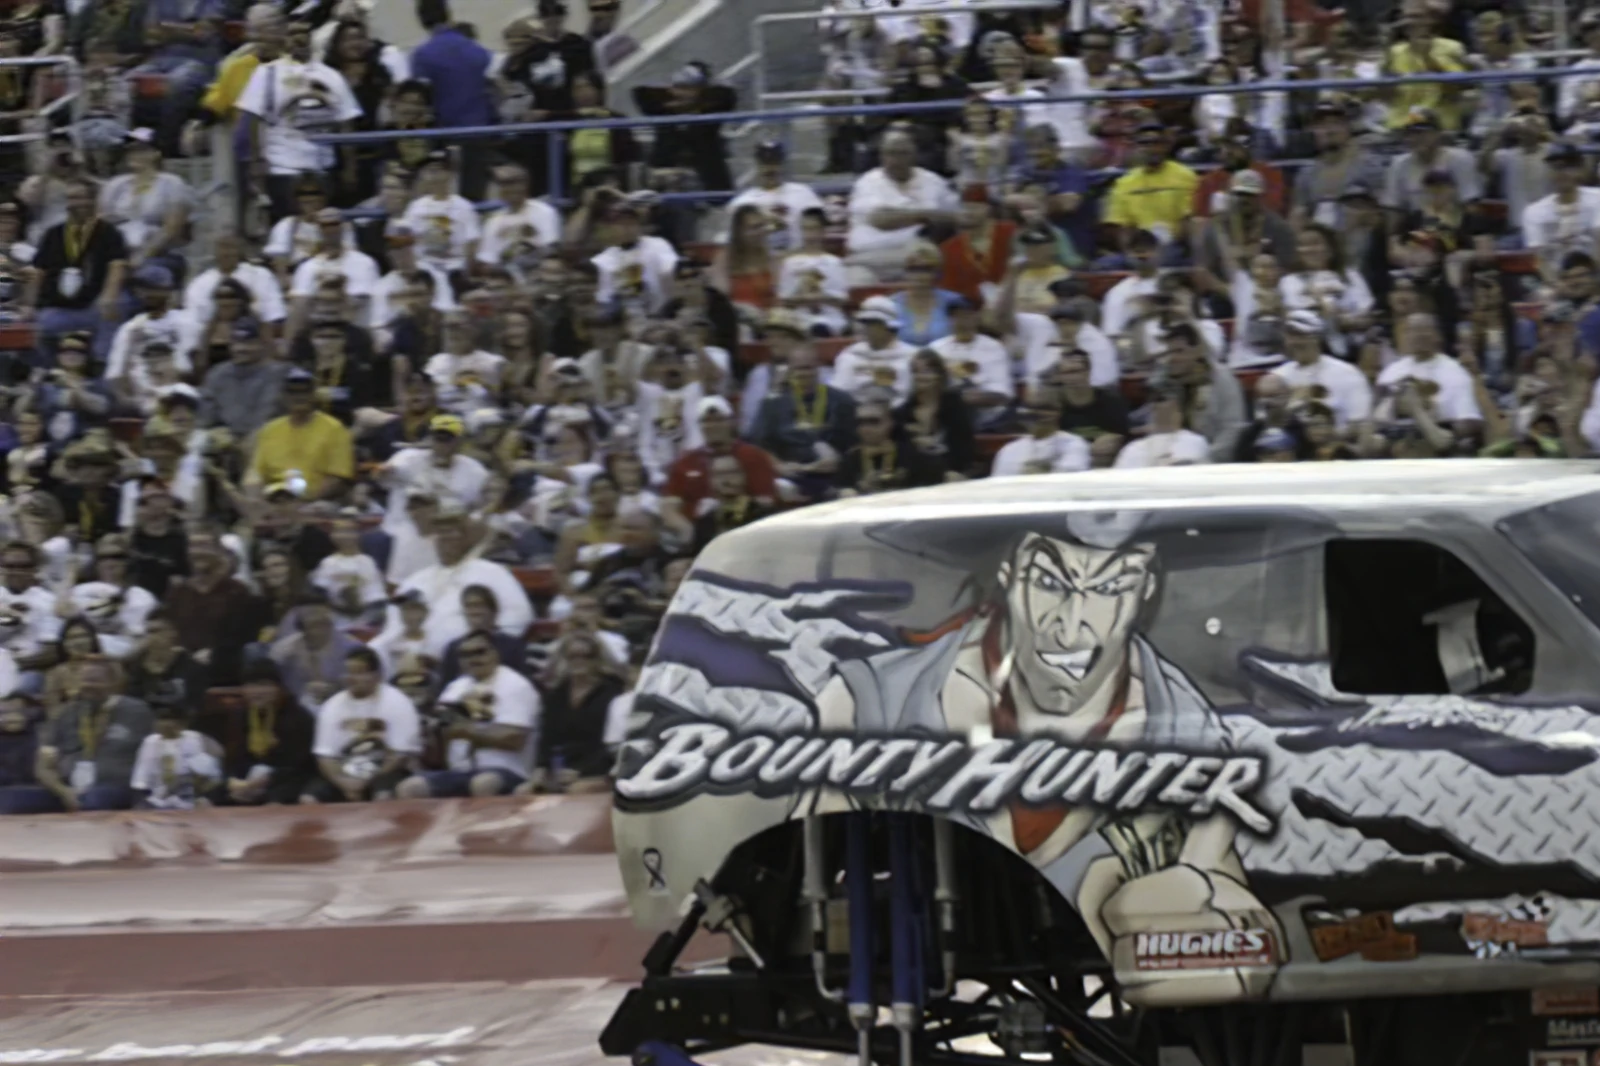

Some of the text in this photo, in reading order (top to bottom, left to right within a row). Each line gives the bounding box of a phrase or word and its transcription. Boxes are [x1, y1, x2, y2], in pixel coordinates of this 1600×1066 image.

[615, 723, 1273, 833] BOUNTY HUNTER
[1136, 929, 1265, 956] HUGHES
